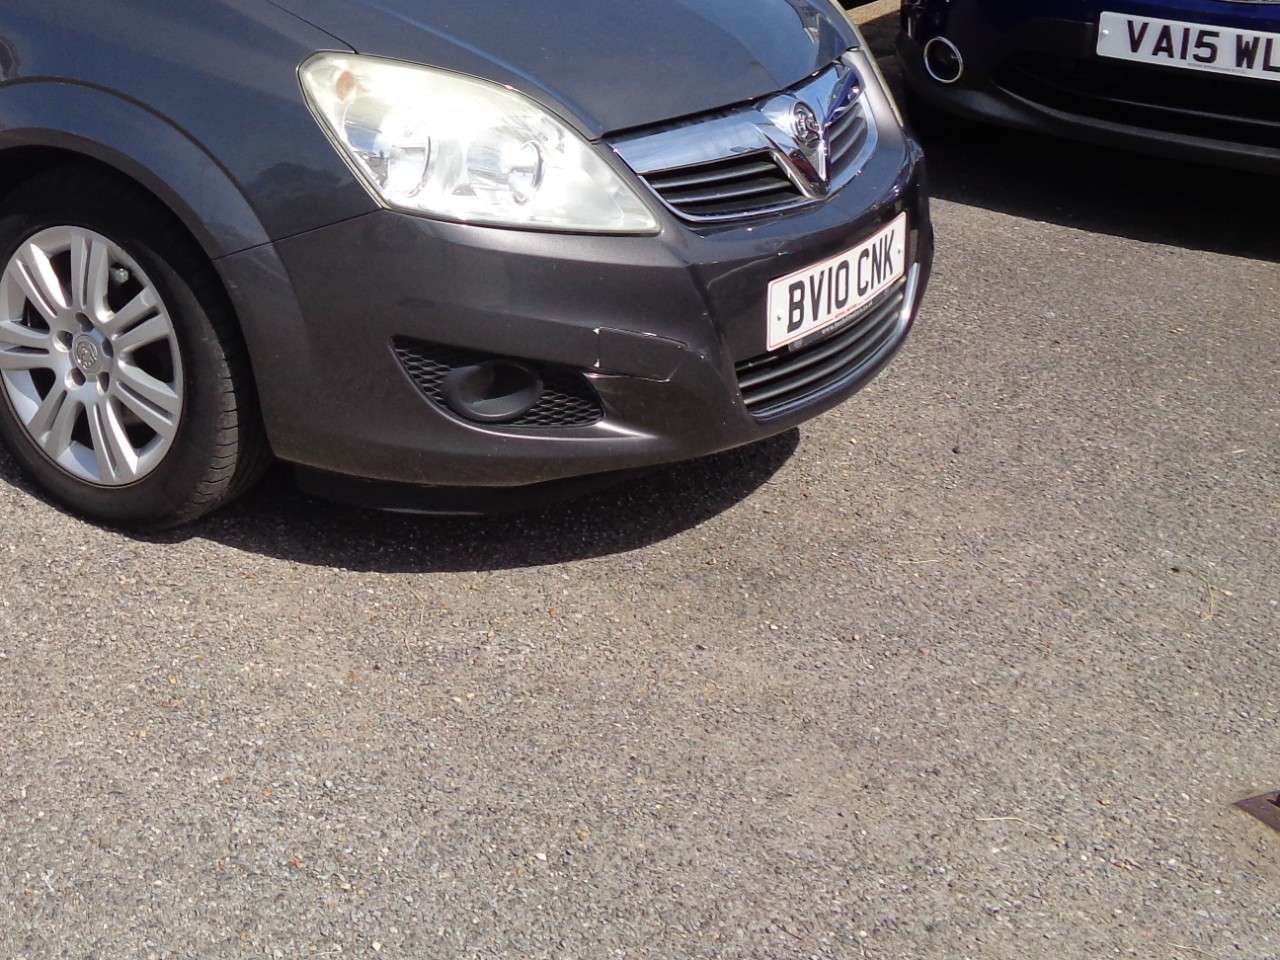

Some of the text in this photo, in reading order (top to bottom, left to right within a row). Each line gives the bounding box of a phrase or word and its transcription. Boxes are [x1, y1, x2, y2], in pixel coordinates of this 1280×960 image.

[1127, 20, 1220, 64] VA15
[787, 259, 849, 333] BV10
[857, 229, 895, 297] CNK
